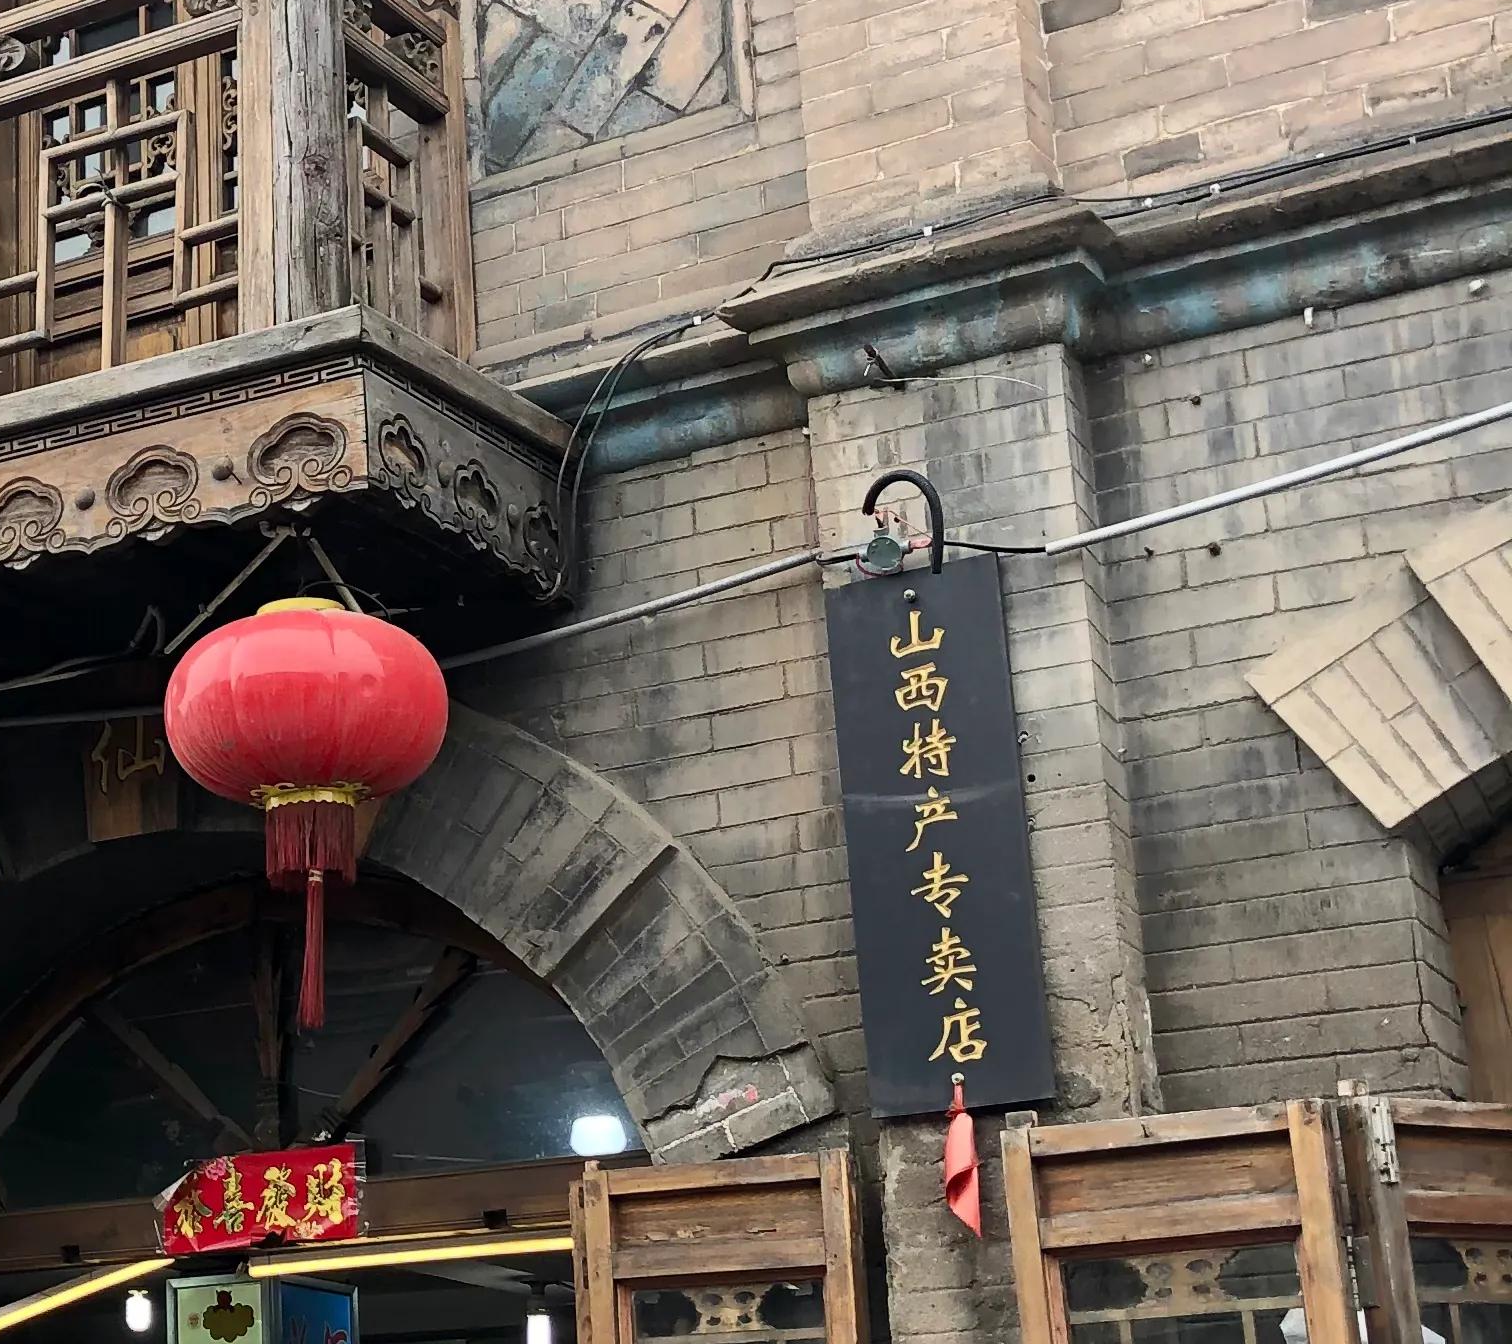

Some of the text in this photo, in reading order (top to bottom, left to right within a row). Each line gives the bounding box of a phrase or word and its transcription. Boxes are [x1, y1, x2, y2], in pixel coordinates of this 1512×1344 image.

[889, 609, 987, 1064] 山西特产专卖店
